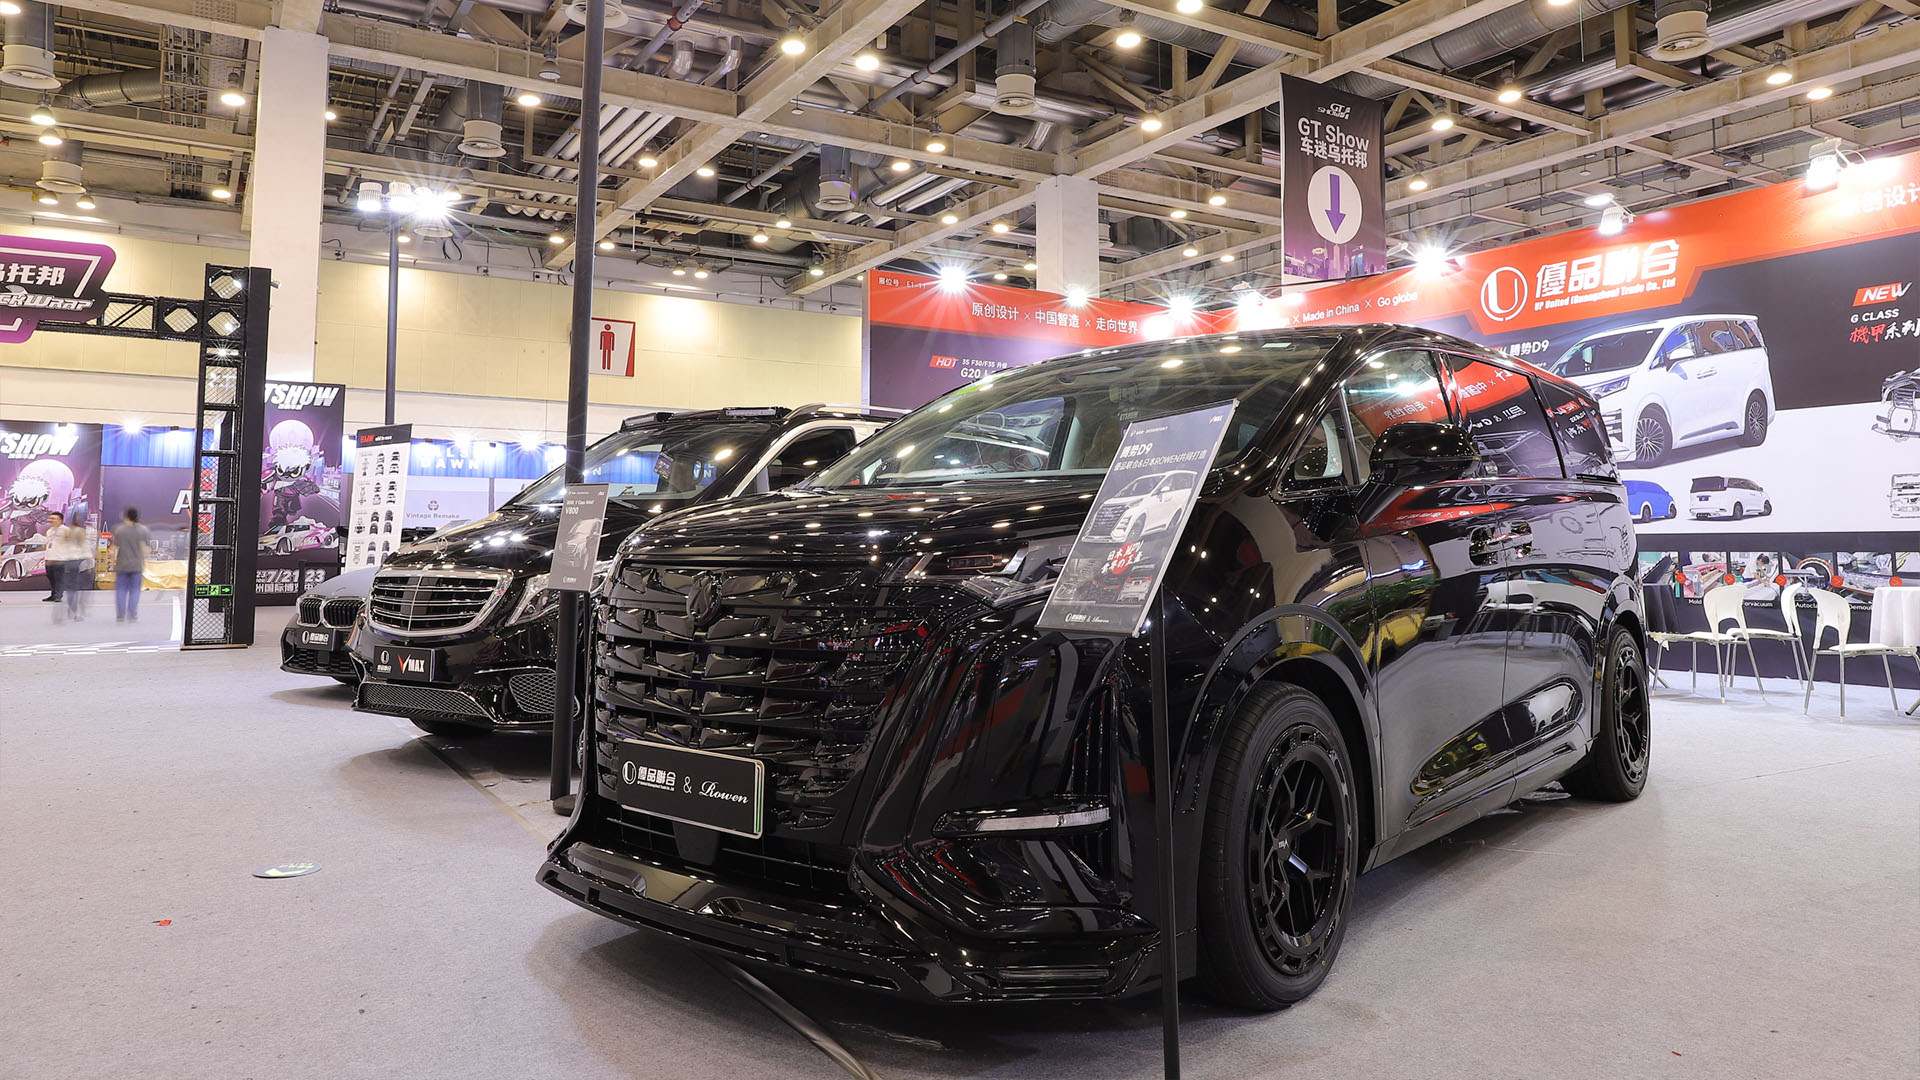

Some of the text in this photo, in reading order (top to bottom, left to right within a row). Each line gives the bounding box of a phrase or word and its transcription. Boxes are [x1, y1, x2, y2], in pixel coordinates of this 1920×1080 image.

[1297, 117, 1370, 152] GT Show
[1301, 137, 1368, 169] 车迷乌托邦
[1545, 296, 1570, 309] United
[1620, 284, 1644, 296] Trade
[1662, 277, 1677, 288] Ltd
[1862, 281, 1912, 302] NEW
[971, 302, 1019, 320] 原创设计
[1035, 309, 1080, 328] 中国智造
[1095, 317, 1138, 334] 走向世界
[1302, 311, 1325, 323] Made
[1326, 308, 1334, 317] in
[1335, 304, 1360, 315] China
[1377, 297, 1391, 307] Go
[1392, 291, 1418, 306] globe
[1850, 308, 1900, 323] G CLASS
[935, 357, 959, 369] HOT
[960, 367, 981, 379] G20
[421, 459, 478, 469] DAWN
[683, 775, 693, 794] &
[699, 780, 749, 804] Rowen
